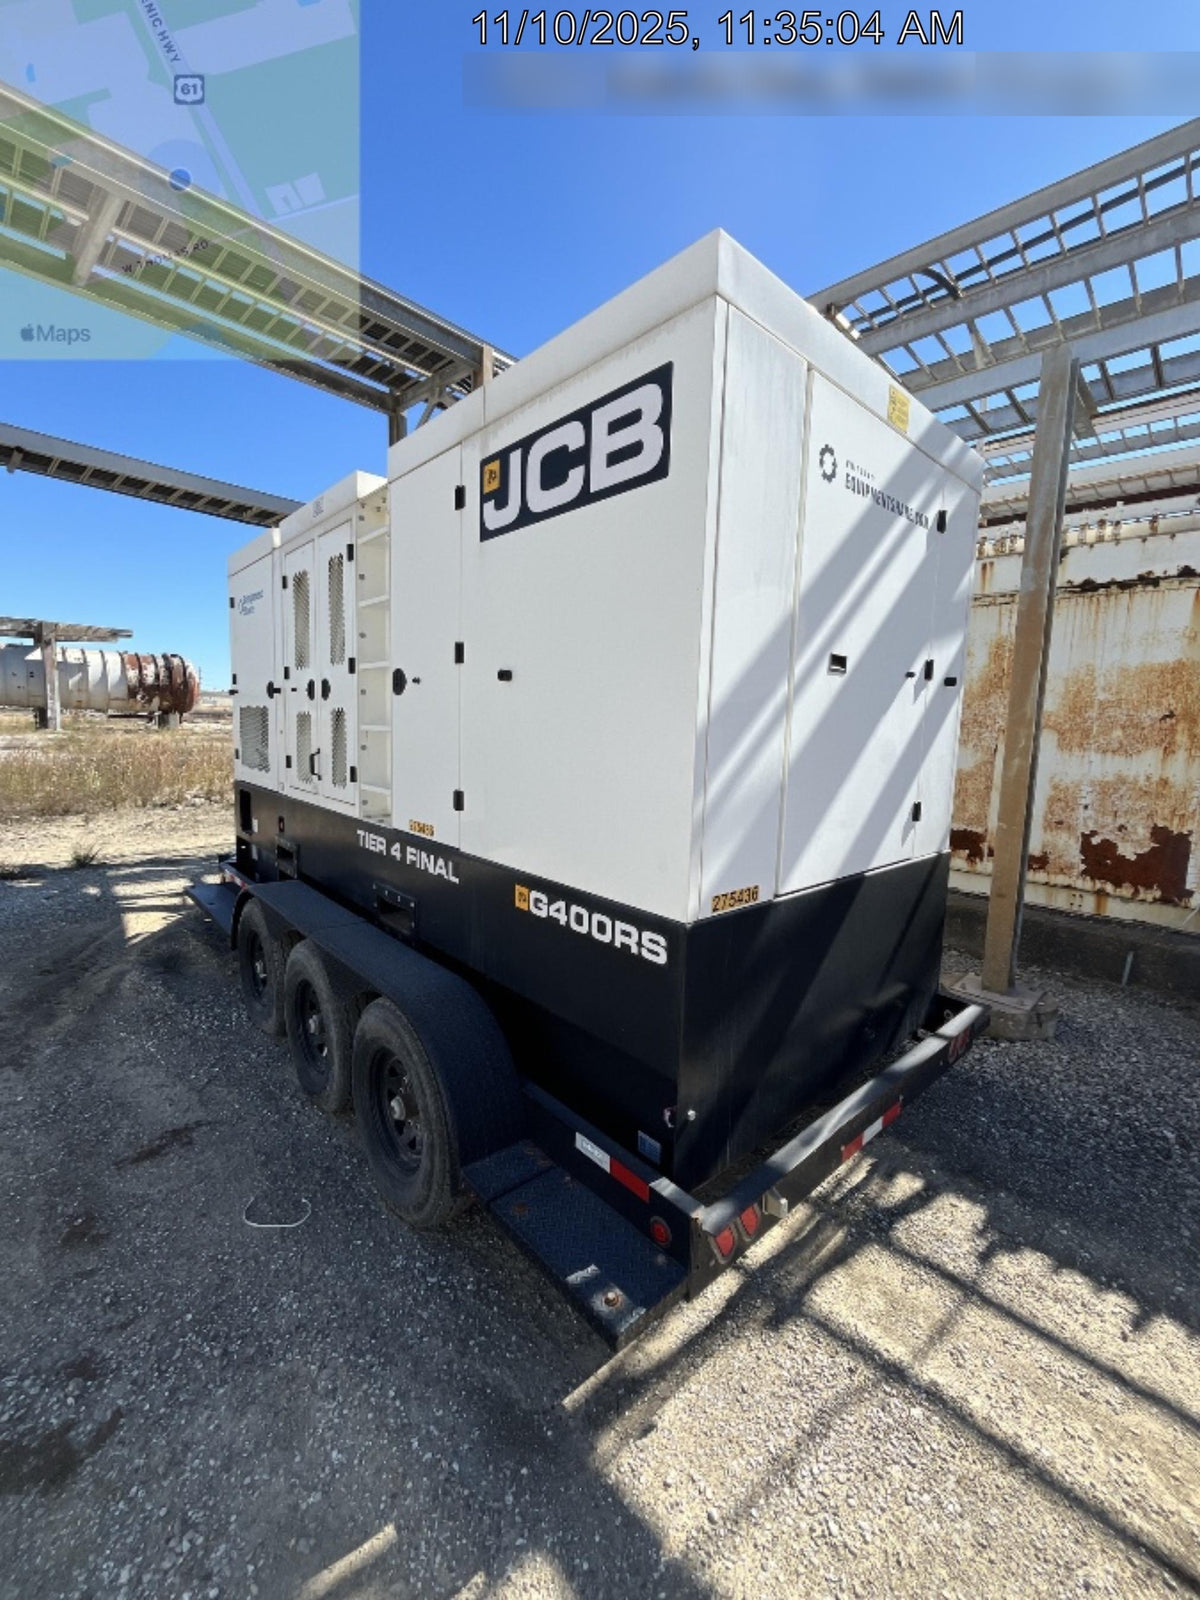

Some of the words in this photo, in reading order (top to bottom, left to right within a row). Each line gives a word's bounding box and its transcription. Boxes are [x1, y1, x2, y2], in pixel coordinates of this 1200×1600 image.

[482, 382, 665, 531] JCB
[356, 829, 387, 856] TIER
[390, 841, 402, 861] 4
[406, 845, 460, 885] FINAL
[528, 889, 668, 966] G400RS
